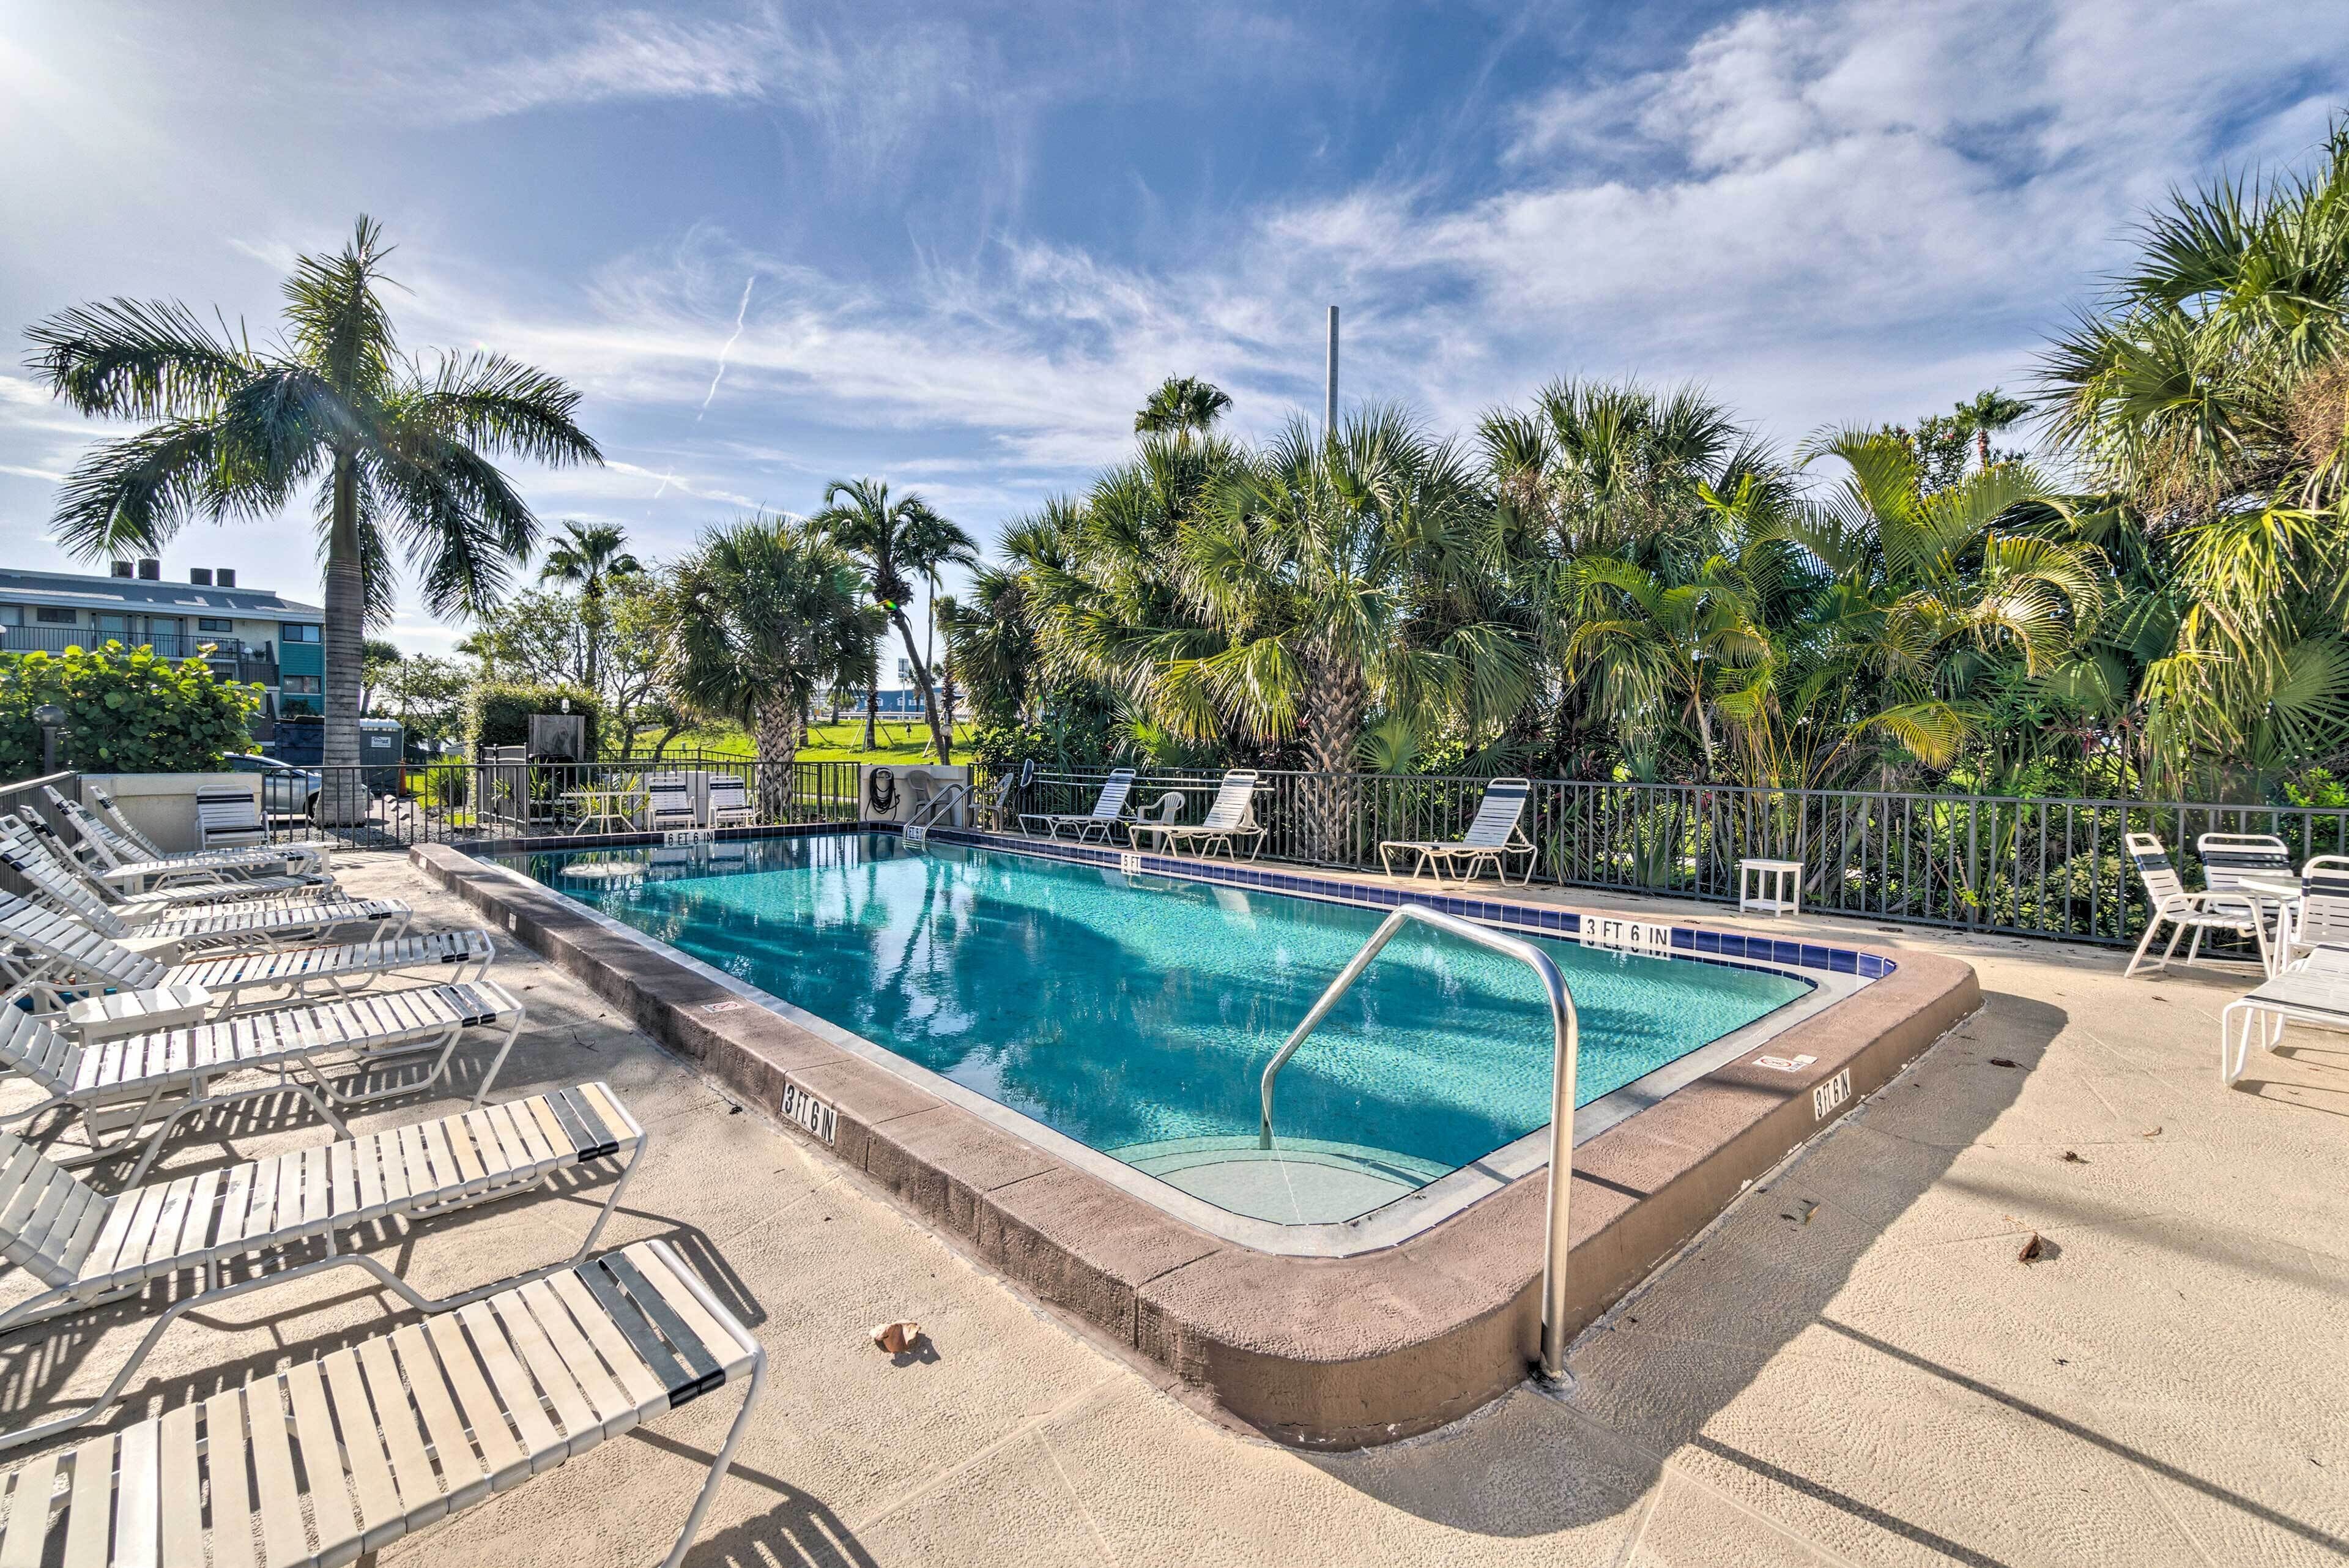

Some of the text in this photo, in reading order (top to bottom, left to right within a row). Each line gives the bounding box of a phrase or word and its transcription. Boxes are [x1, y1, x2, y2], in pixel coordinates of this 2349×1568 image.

[668, 833, 674, 845] 6
[693, 832, 699, 844] 6
[703, 832, 713, 843] IN
[1124, 855, 1140, 868] 5 FT
[1587, 919, 1668, 945] 3 FT 6 IN
[1816, 1090, 1822, 1118] 3
[1833, 1077, 1839, 1103] 6
[785, 1085, 834, 1143] 3 FT. 6 IN.
